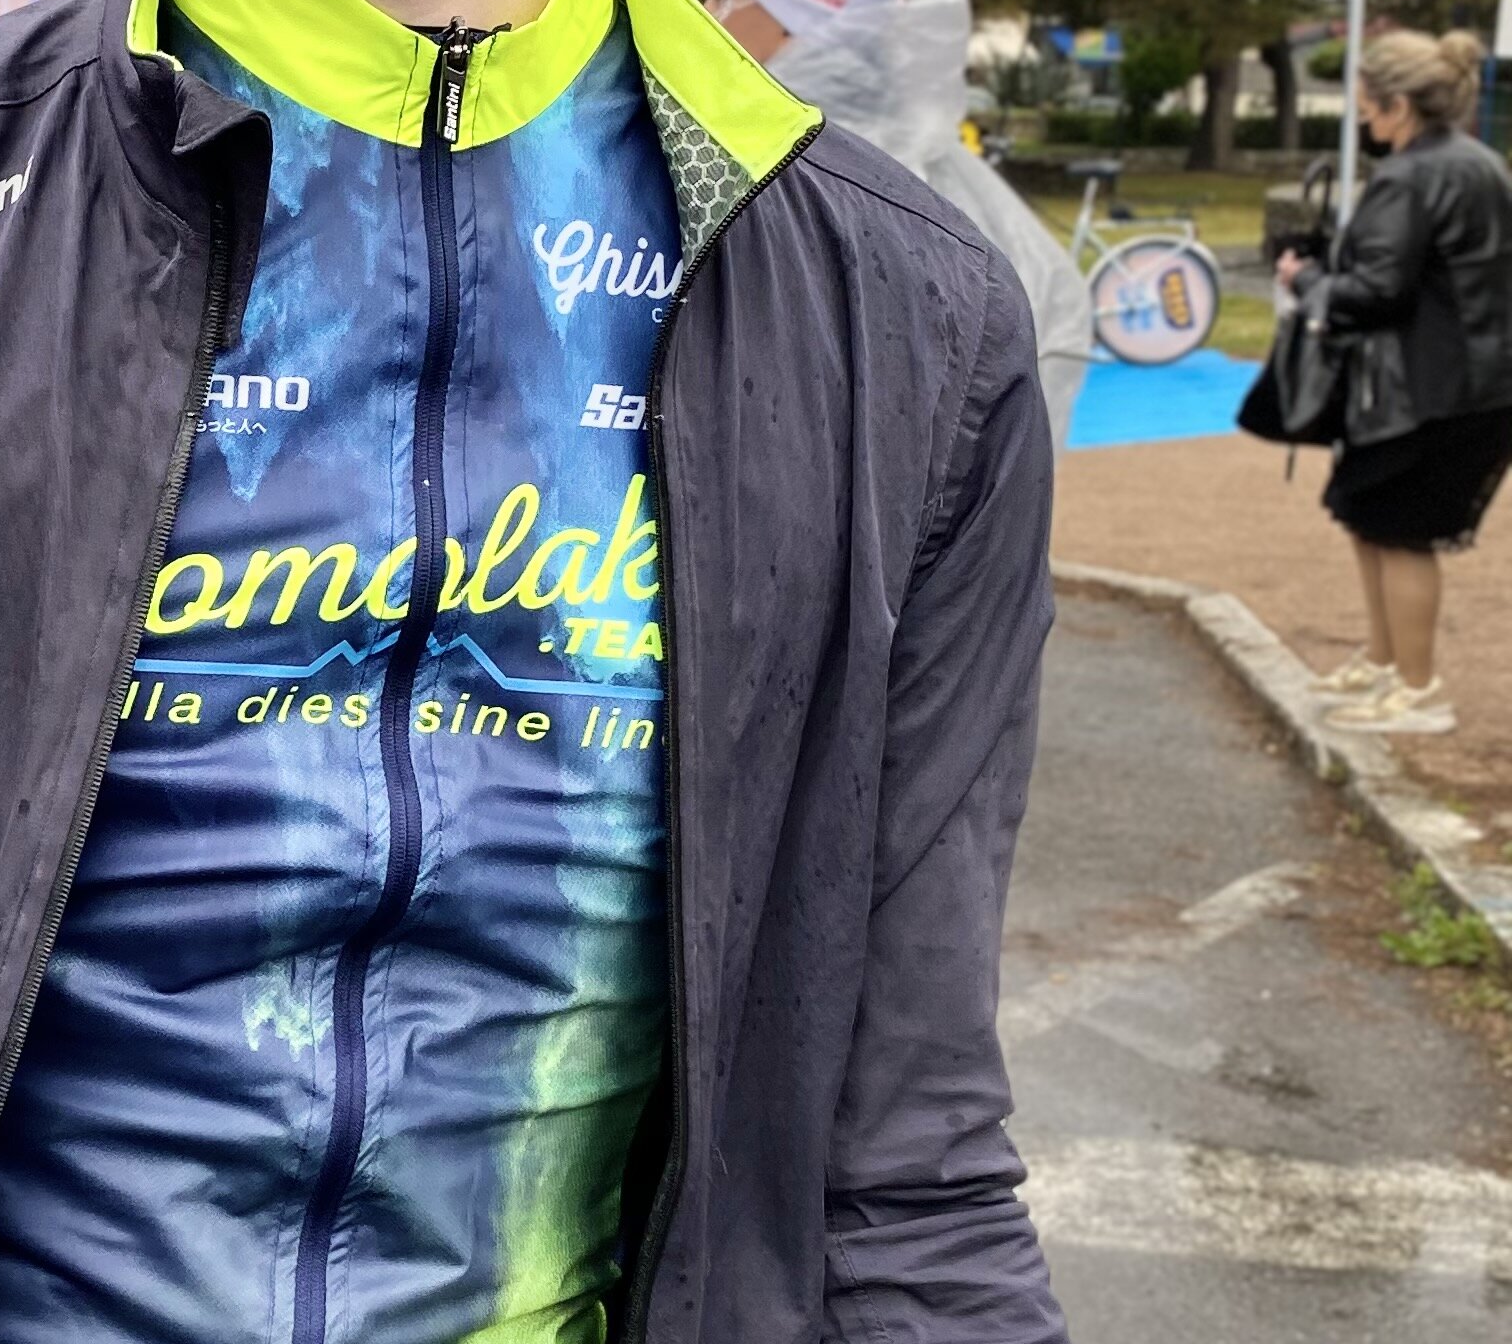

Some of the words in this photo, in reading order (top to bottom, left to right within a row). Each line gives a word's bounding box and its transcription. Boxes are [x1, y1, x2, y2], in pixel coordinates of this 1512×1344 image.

[579, 383, 649, 431] Sa
[237, 686, 371, 727] dies
[410, 692, 552, 742] sine
[580, 705, 662, 749] lin
